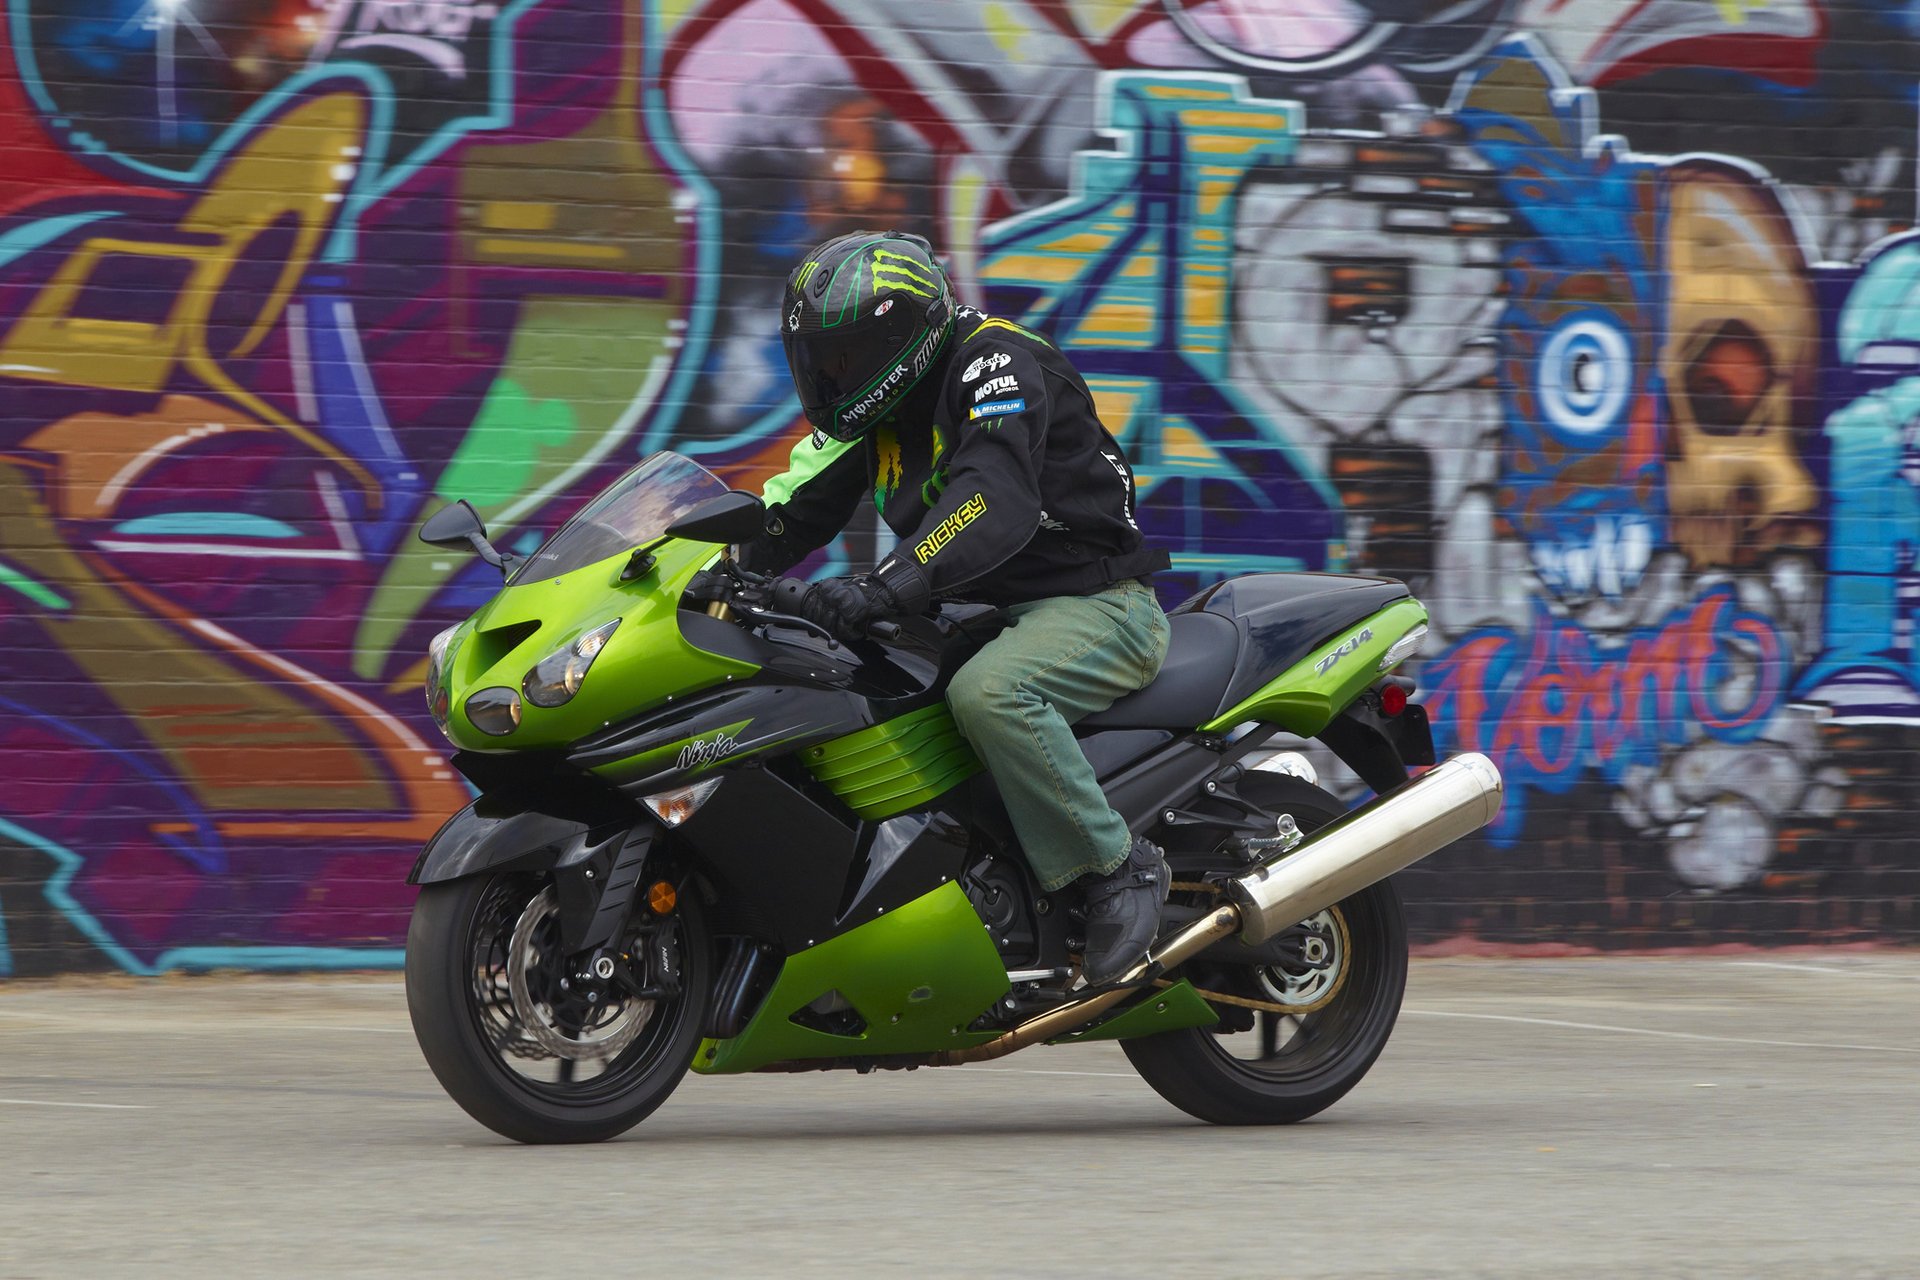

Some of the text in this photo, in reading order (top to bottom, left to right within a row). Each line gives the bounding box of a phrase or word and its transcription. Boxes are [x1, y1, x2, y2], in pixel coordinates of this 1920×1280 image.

[842, 364, 908, 423] MONSTER
[974, 375, 1018, 402] MOTUL
[981, 402, 1020, 412] MICHELIN
[914, 492, 987, 565] RICKEY
[1314, 626, 1374, 677] ZX-14
[676, 732, 739, 770] Ninja
